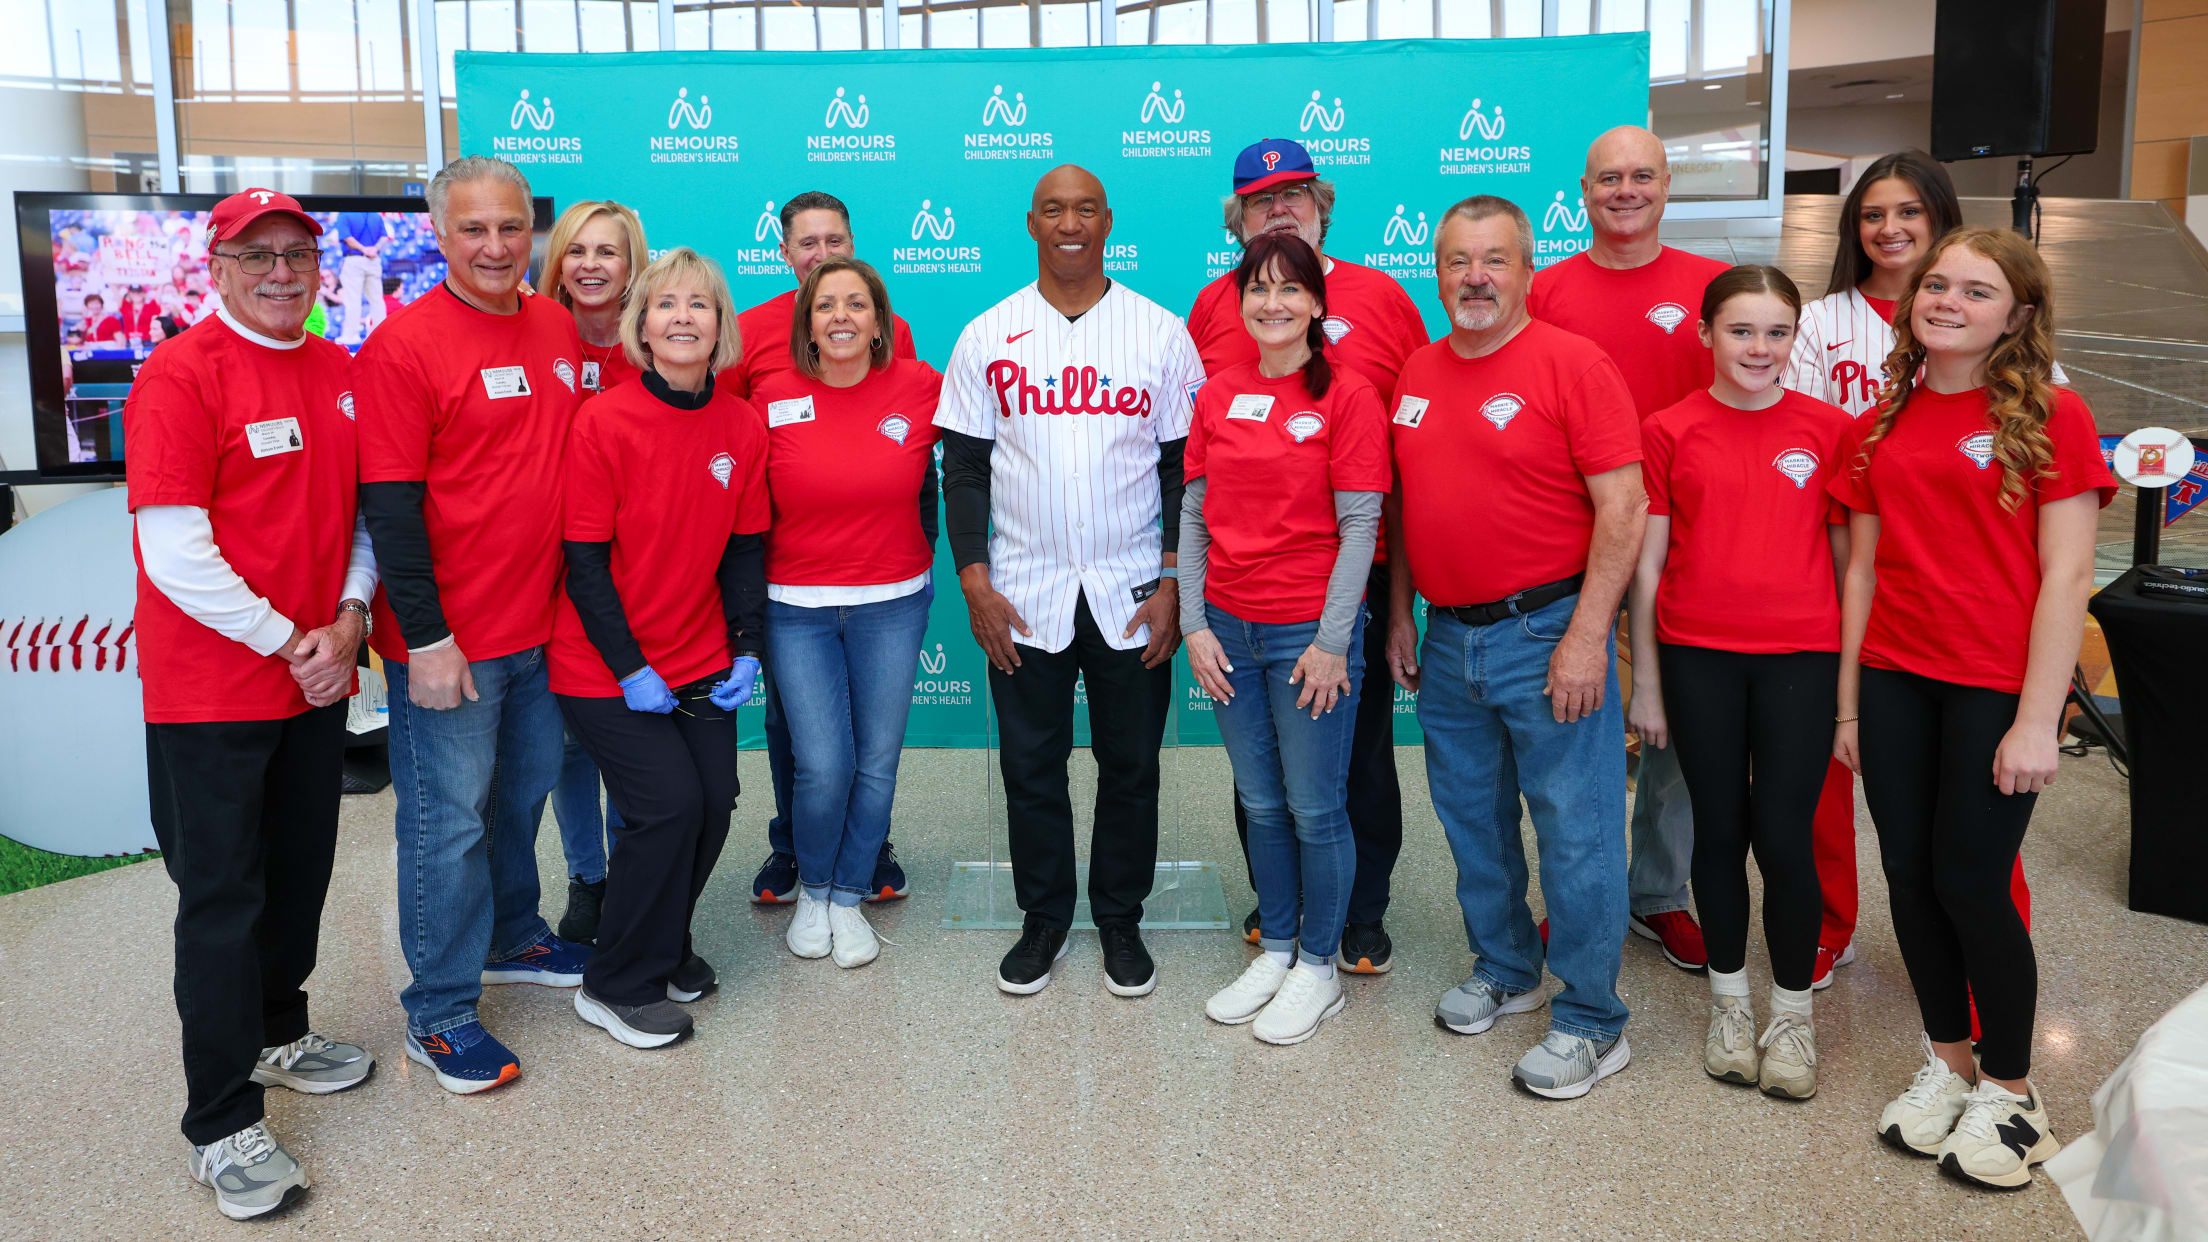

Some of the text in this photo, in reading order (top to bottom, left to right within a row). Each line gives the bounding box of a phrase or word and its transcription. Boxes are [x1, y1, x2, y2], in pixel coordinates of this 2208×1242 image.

[493, 136, 582, 150] NEMOURS
[650, 135, 739, 150] NEMOURS
[807, 135, 895, 149] NEMOURS
[964, 132, 1053, 147] NEMOURS
[1122, 130, 1211, 145] NEMOURS
[1122, 146, 1211, 157] CHILDREN'S HEALTH
[1296, 138, 1370, 153] MOURS
[494, 153, 583, 163] CHILDREN'S HEALTH
[650, 152, 739, 163] CHILDREN'S HEALTH
[807, 151, 896, 162] CHILDREN'S HEALTH
[964, 149, 1053, 160] CHILDREN'S HEALTH
[1336, 154, 1370, 165] HEALTH
[1440, 146, 1531, 161] NEMOURS
[1263, 151, 1280, 170] P
[1440, 162, 1530, 175] CHILDREN'S HEALTH
[1533, 239, 1593, 252] EMOU
[893, 247, 981, 261] NEMOURS
[1364, 252, 1436, 267] NEMOU
[893, 263, 981, 274] CHILDREN'S HEALTH
[1104, 261, 1138, 271] HEALTH
[985, 358, 1152, 419] Phillies
[913, 680, 971, 693] MOURS
[912, 695, 972, 705] REN'S HEALTH
[1393, 704, 1416, 714] HEAL
